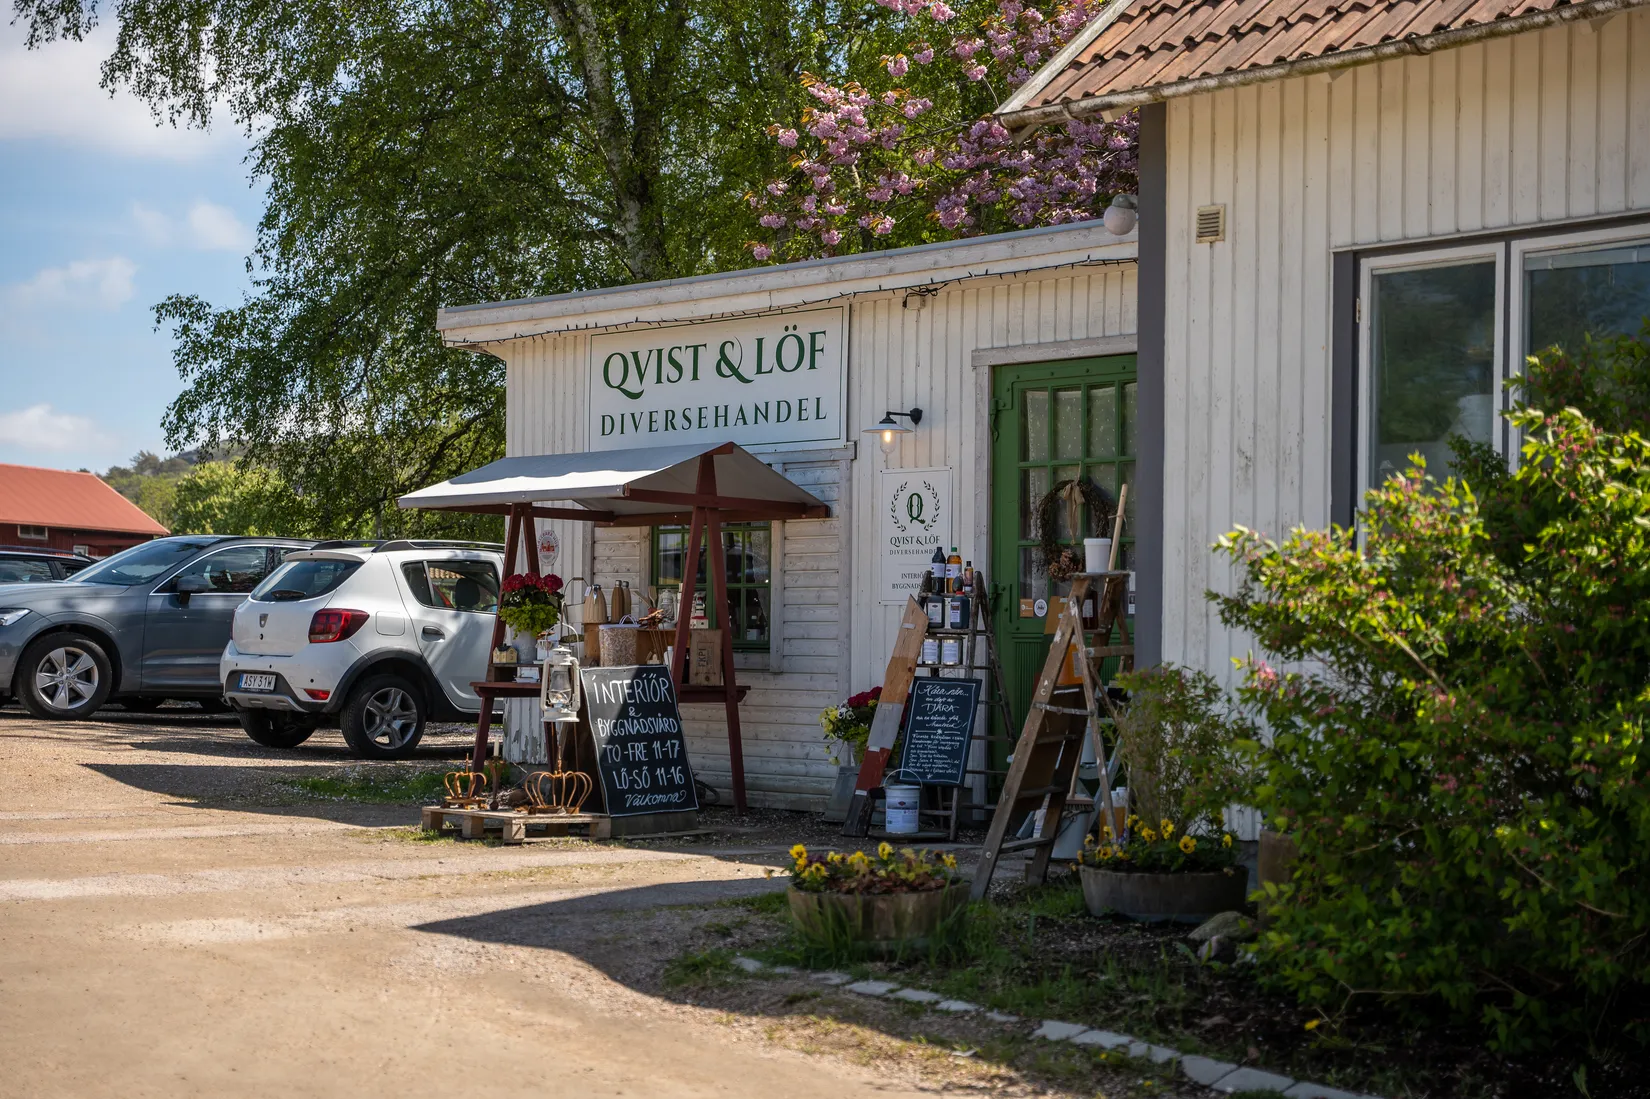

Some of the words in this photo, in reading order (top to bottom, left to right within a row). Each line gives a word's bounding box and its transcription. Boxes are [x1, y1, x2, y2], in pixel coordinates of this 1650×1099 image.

[603, 343, 707, 400] QVIST
[715, 336, 754, 384] &
[754, 324, 827, 376] LÖF
[600, 397, 828, 437] DIVERSEHANDEL
[906, 492, 926, 524] Q
[890, 536, 915, 547] QVIST
[915, 536, 924, 546] &
[924, 534, 940, 544] LÖF
[243, 675, 257, 687] ASY
[628, 706, 642, 718] &
[921, 703, 960, 714] TJÄRA
[597, 713, 678, 737] BYGGNADSVÅRD
[652, 740, 680, 760] 11-17
[613, 767, 650, 790] LÖ-SÖ
[655, 766, 685, 786] 11-16
